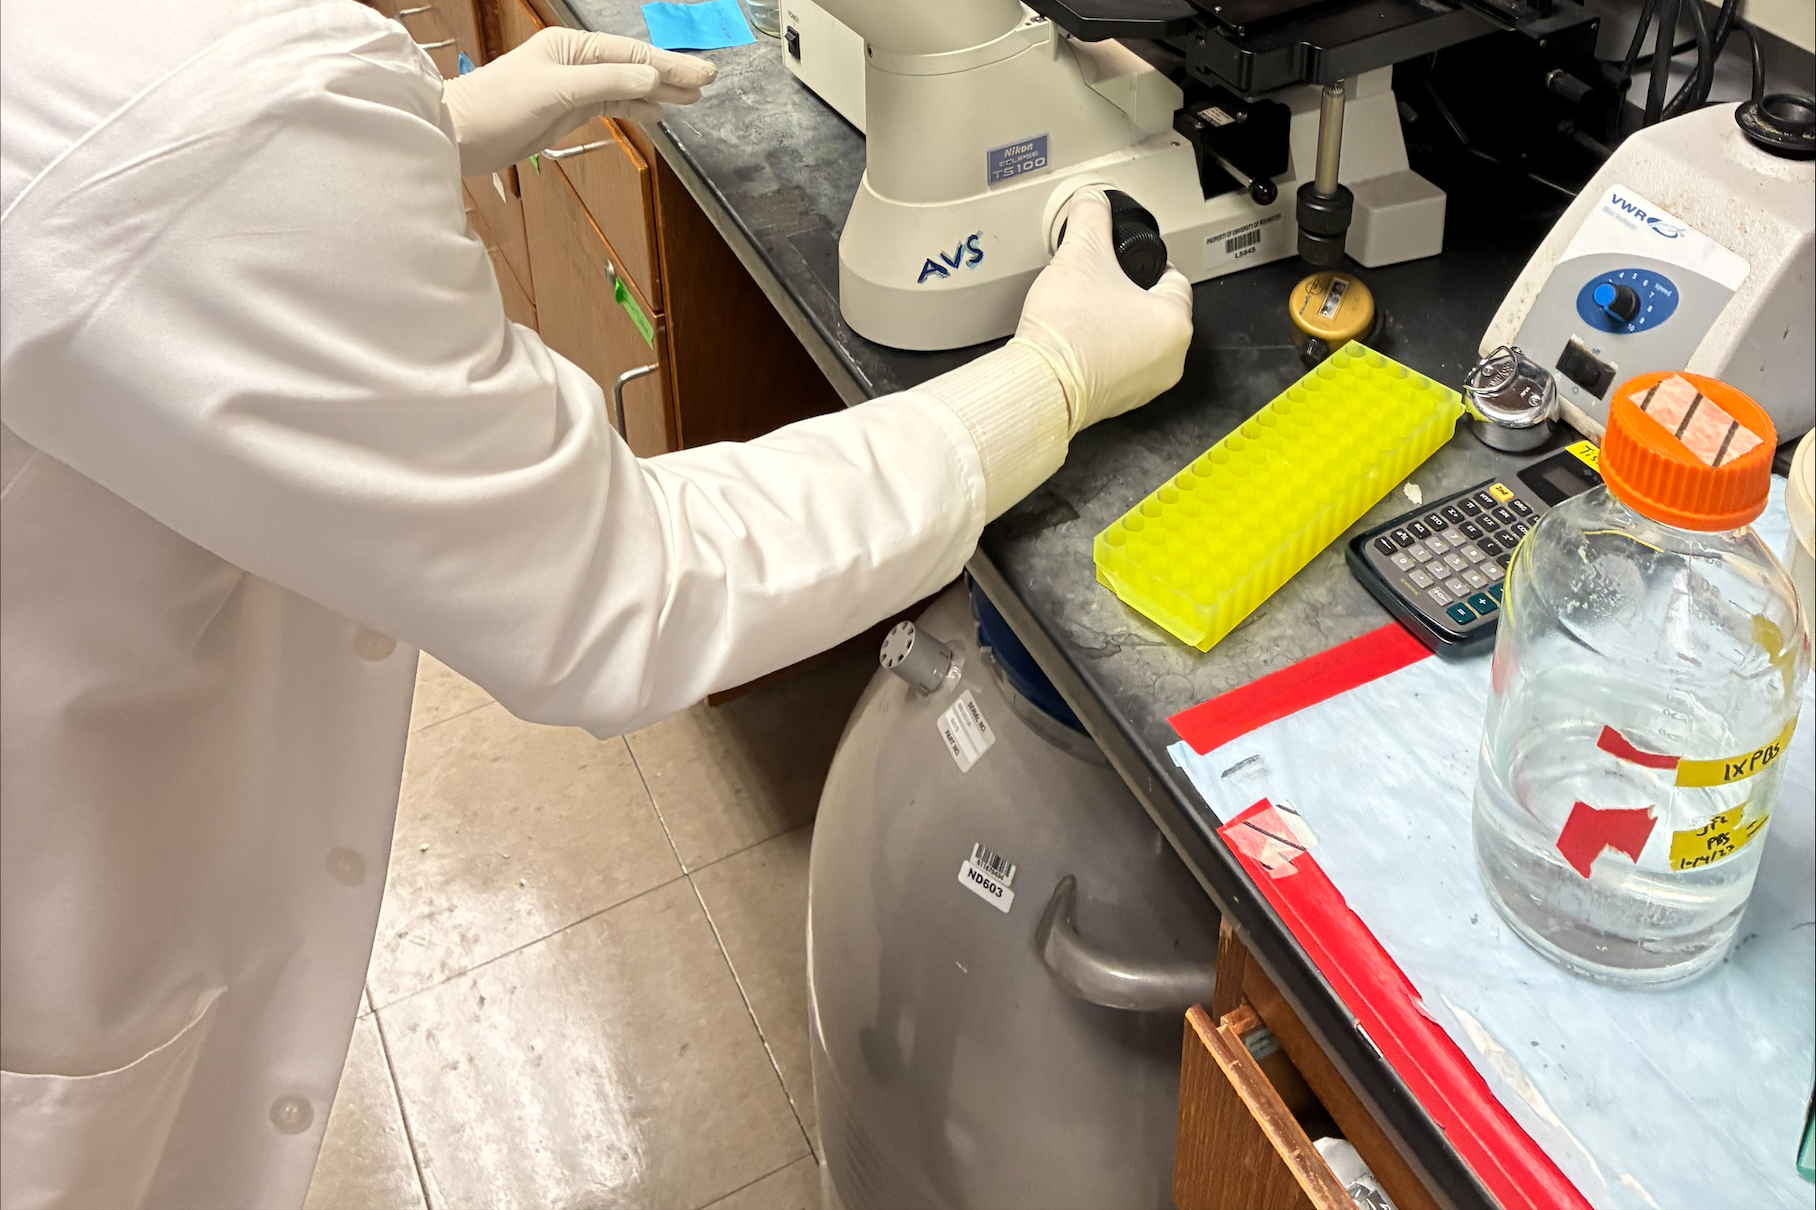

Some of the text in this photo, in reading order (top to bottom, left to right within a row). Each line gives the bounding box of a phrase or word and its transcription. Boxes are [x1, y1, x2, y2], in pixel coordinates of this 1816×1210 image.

[998, 150, 1039, 167] ECLIPSE
[1004, 142, 1034, 158] Nikon
[992, 157, 1046, 179] TS100
[1611, 193, 1648, 221] VWR
[917, 233, 984, 283] AVS
[1632, 272, 1638, 280] 5
[1643, 279, 1649, 287] 6
[1430, 515, 1443, 525] STO
[967, 701, 981, 723] SERIAL
[945, 729, 955, 745] PART
[967, 867, 1003, 898] ND603
